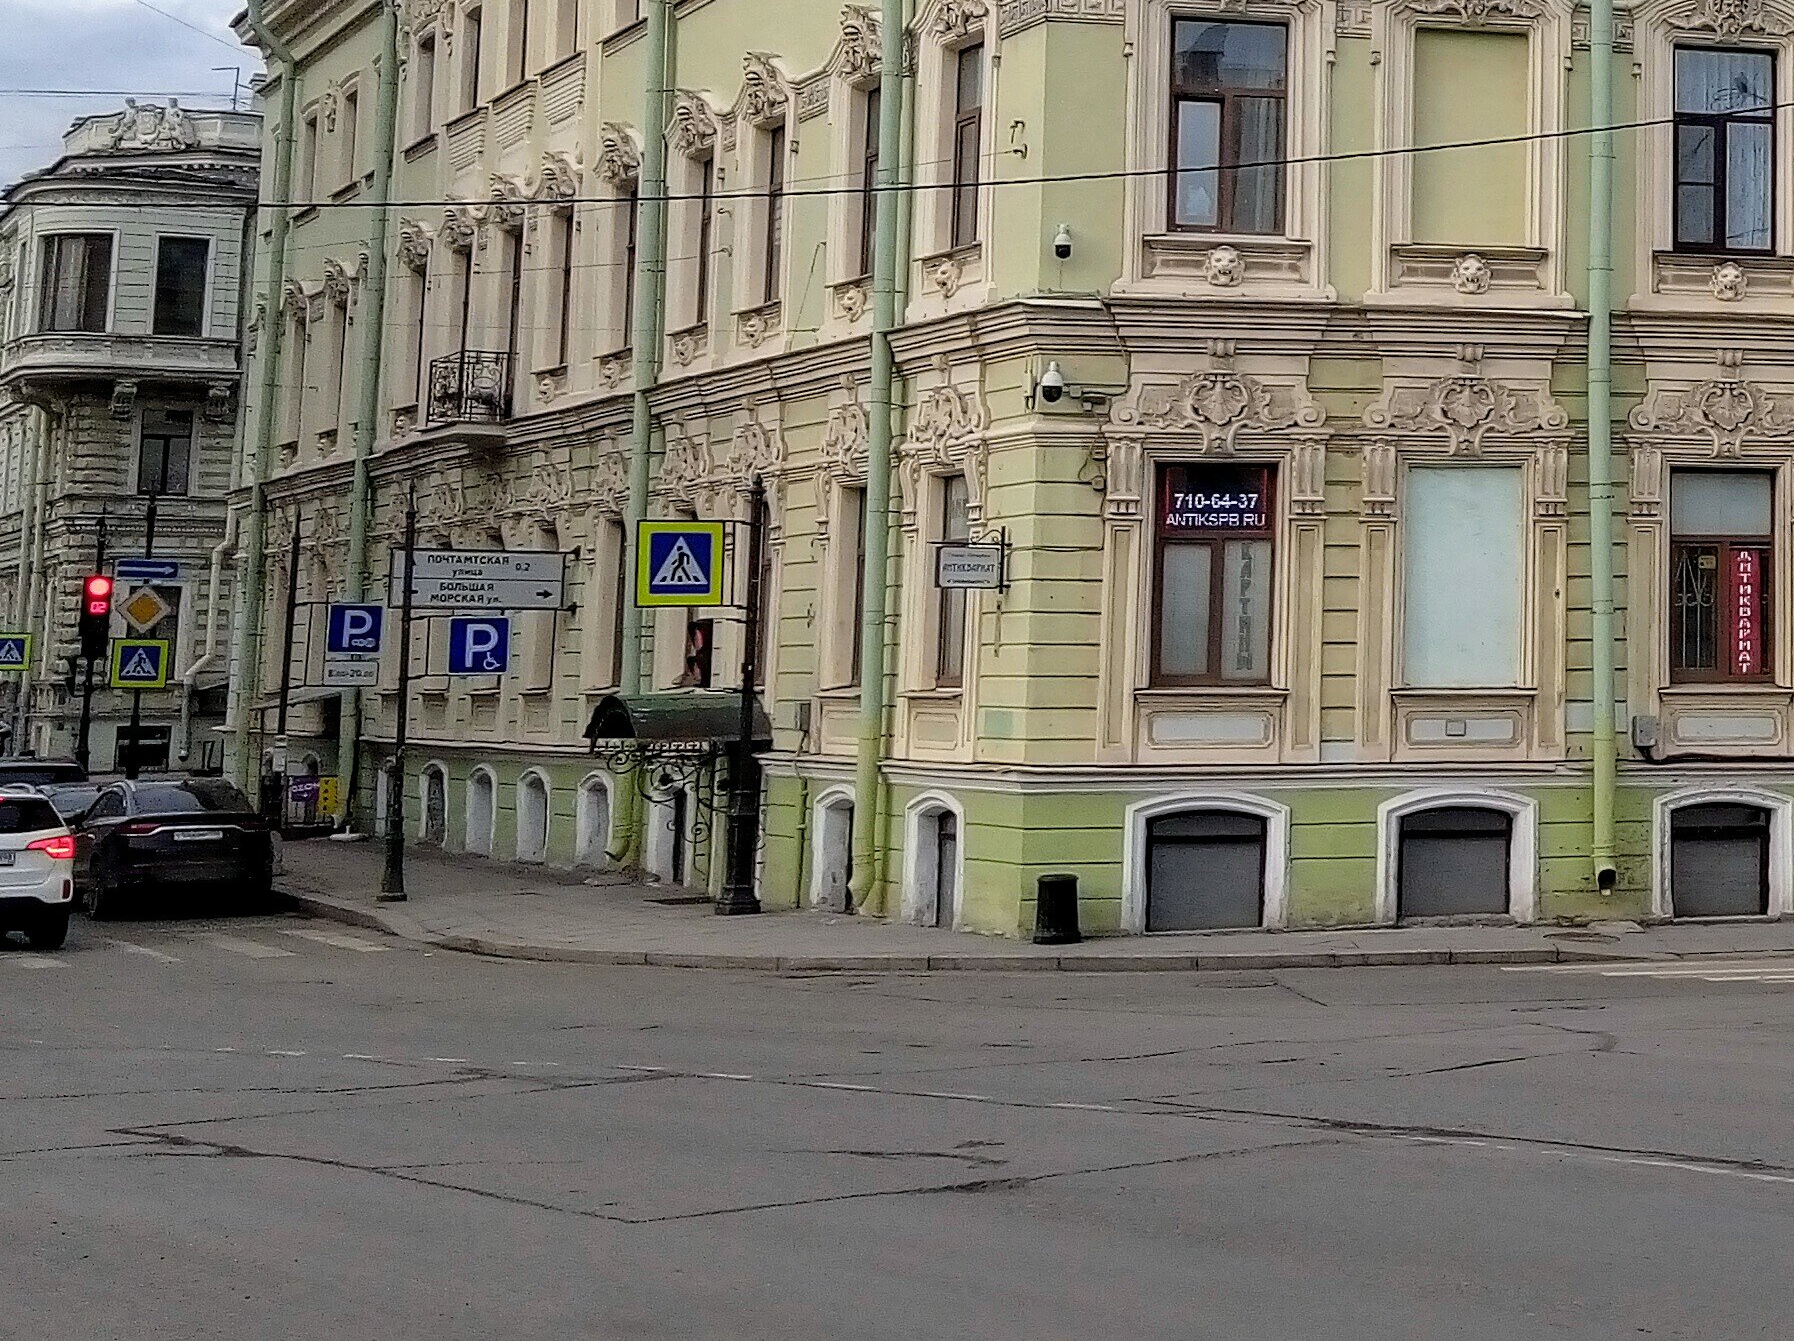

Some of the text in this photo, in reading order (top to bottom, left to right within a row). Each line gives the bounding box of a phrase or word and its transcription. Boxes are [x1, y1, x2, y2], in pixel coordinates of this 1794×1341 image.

[1173, 493, 1259, 509] 710-64-37
[1165, 513, 1266, 527] ANTIKSPB.RU
[427, 554, 510, 565] ПОЧТАМТСКАЯ
[452, 568, 483, 578] улица
[439, 582, 495, 592] БОЛЬШАЯ
[430, 594, 484, 604] МОРСКАЯ
[90, 601, 107, 613] 02
